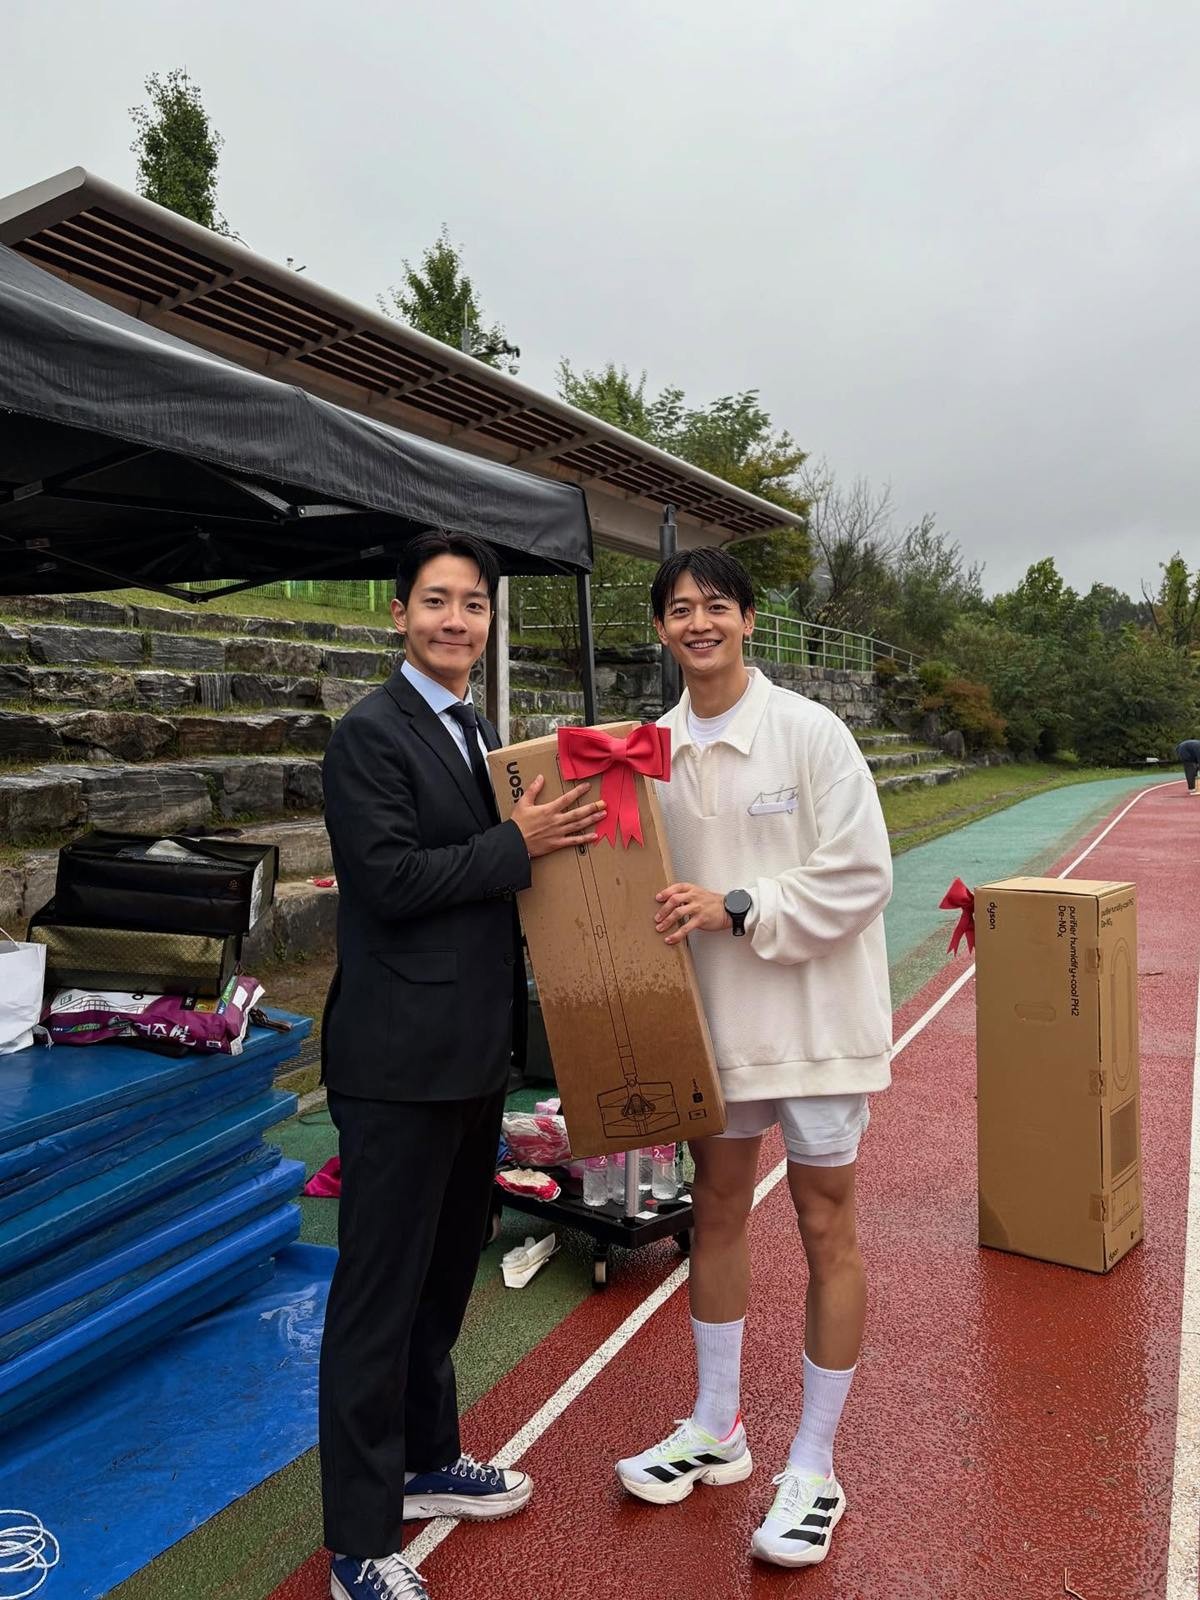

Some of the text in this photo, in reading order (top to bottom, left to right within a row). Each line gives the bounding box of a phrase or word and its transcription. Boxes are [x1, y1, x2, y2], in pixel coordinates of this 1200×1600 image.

[507, 761, 525, 804] son
[986, 901, 997, 931] dyson
[1067, 904, 1078, 937] purifier
[1071, 998, 1080, 1017] PH2
